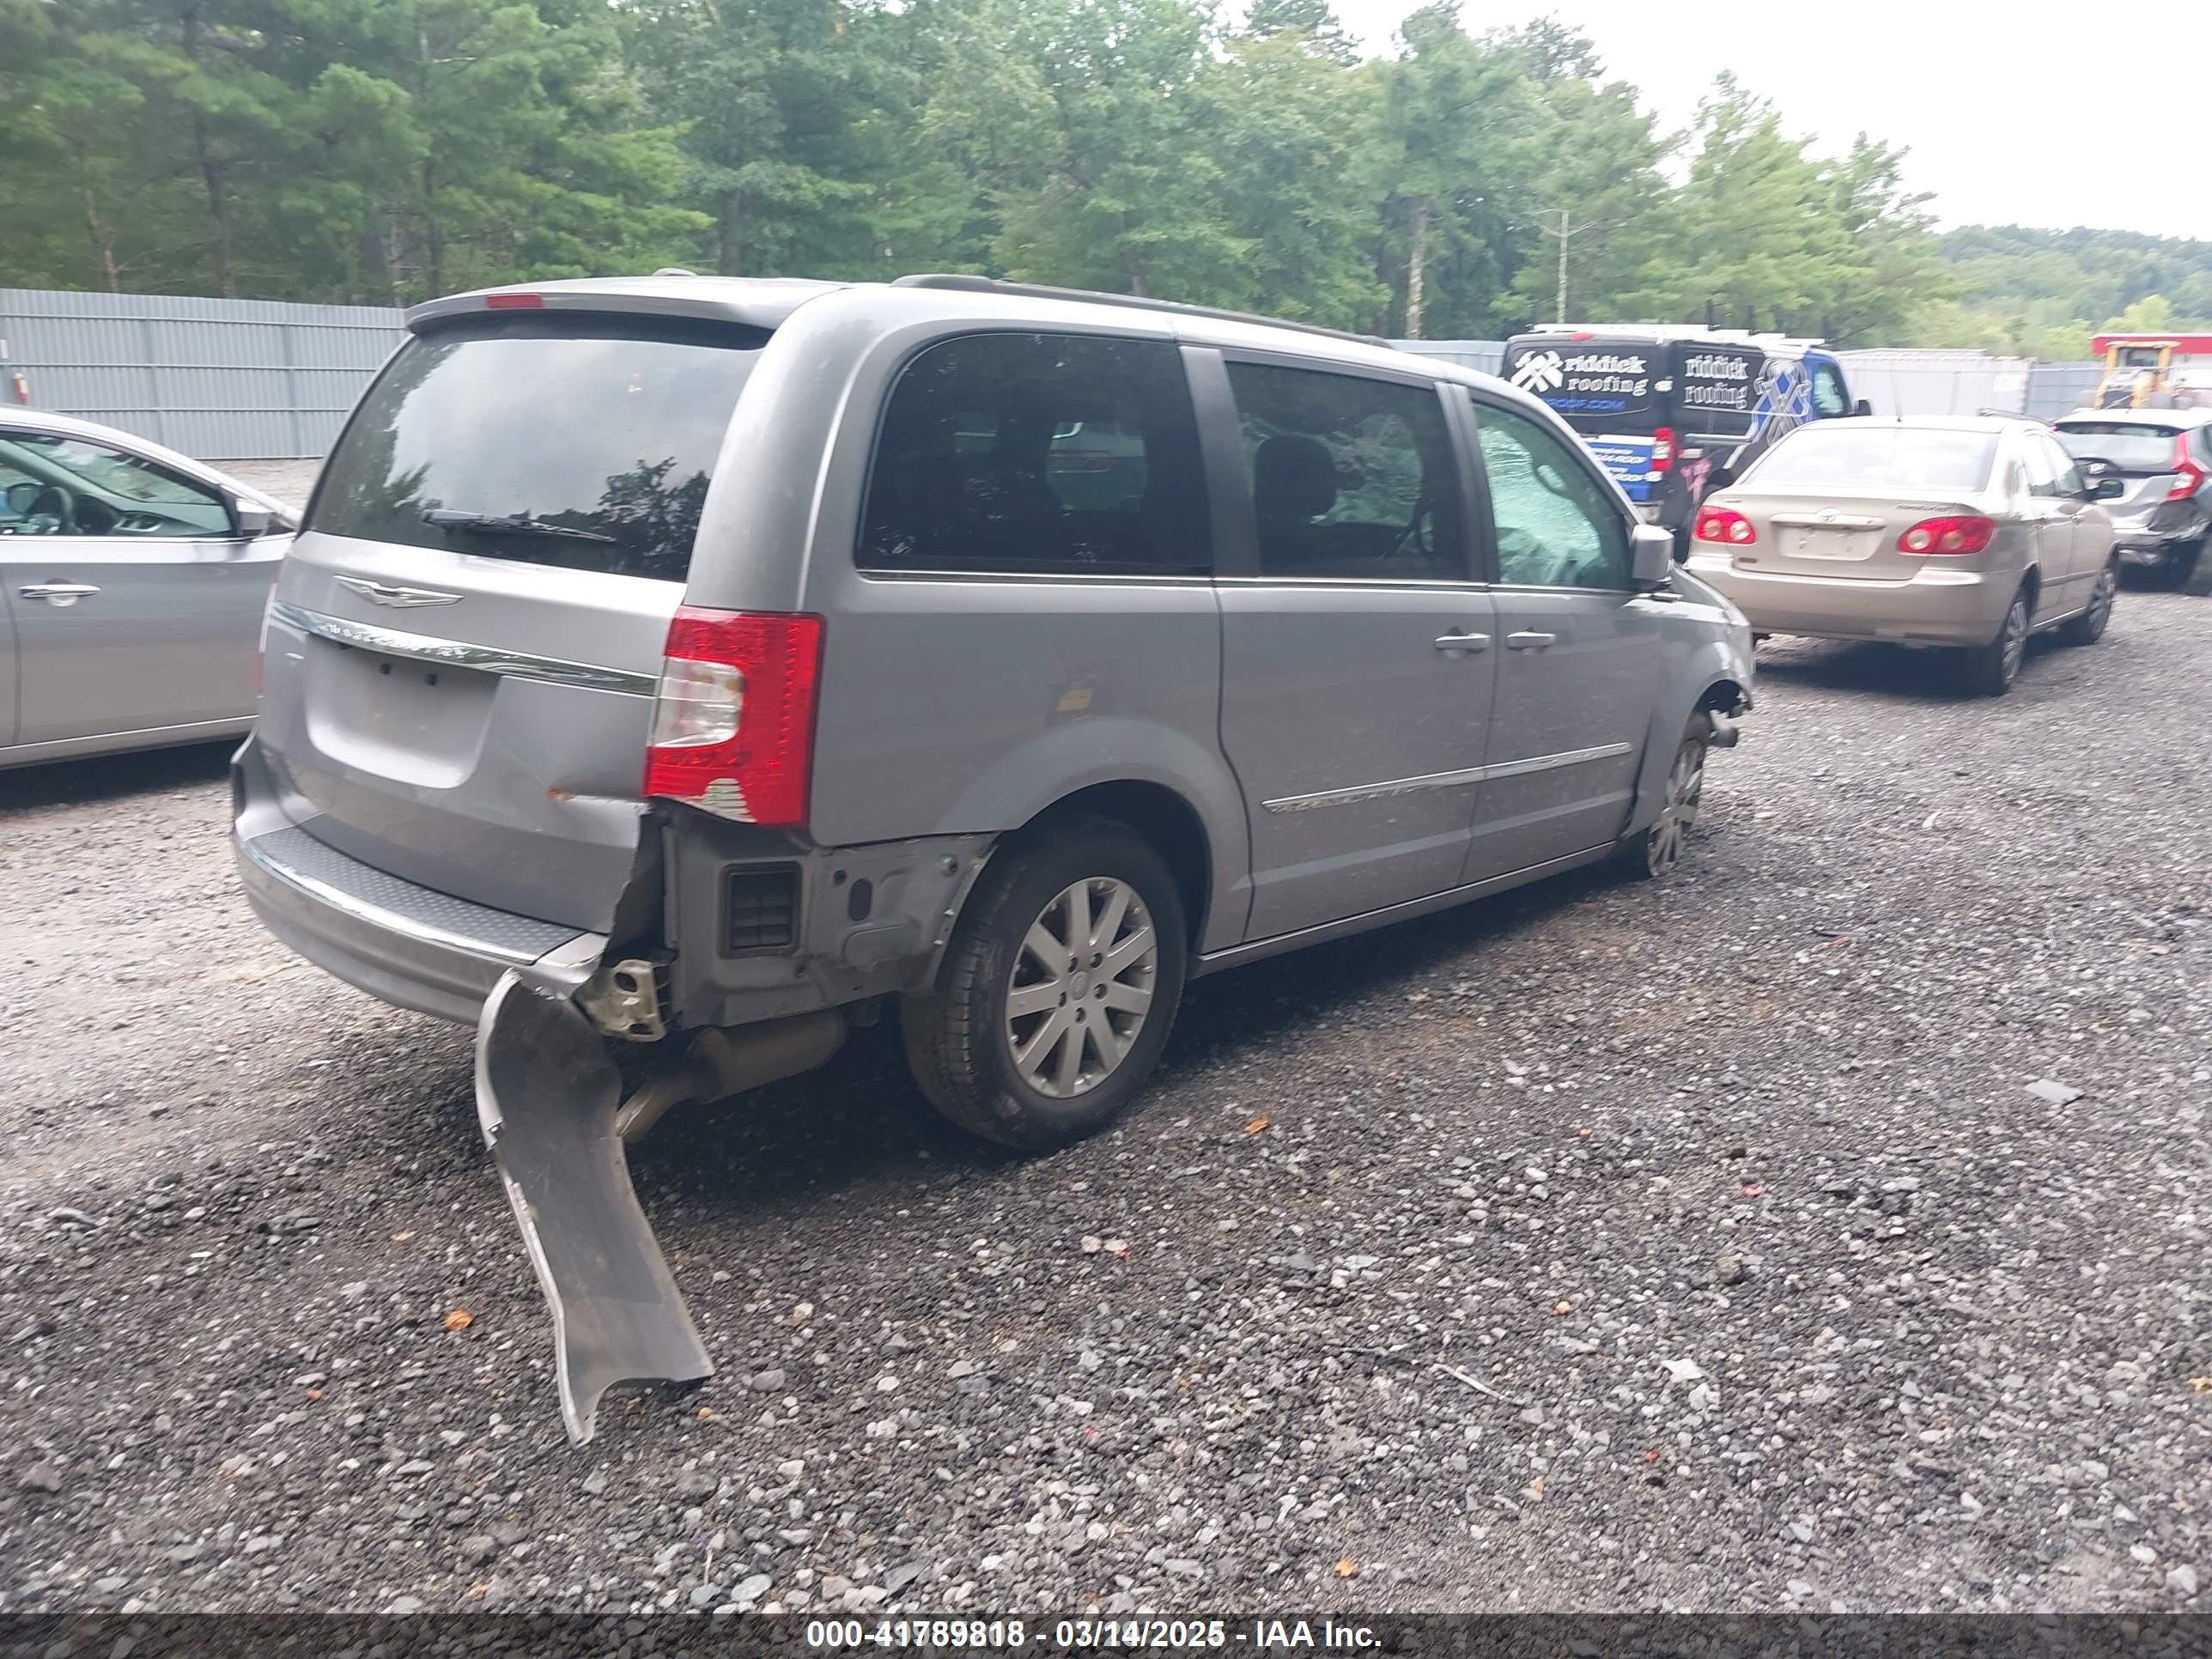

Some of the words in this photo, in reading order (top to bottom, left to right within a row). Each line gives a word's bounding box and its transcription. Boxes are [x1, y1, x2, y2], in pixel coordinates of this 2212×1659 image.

[1563, 355, 1647, 374] riddick
[1685, 355, 1749, 380] riddick
[1566, 375, 1649, 397] roofing
[1683, 381, 1748, 410] roofing
